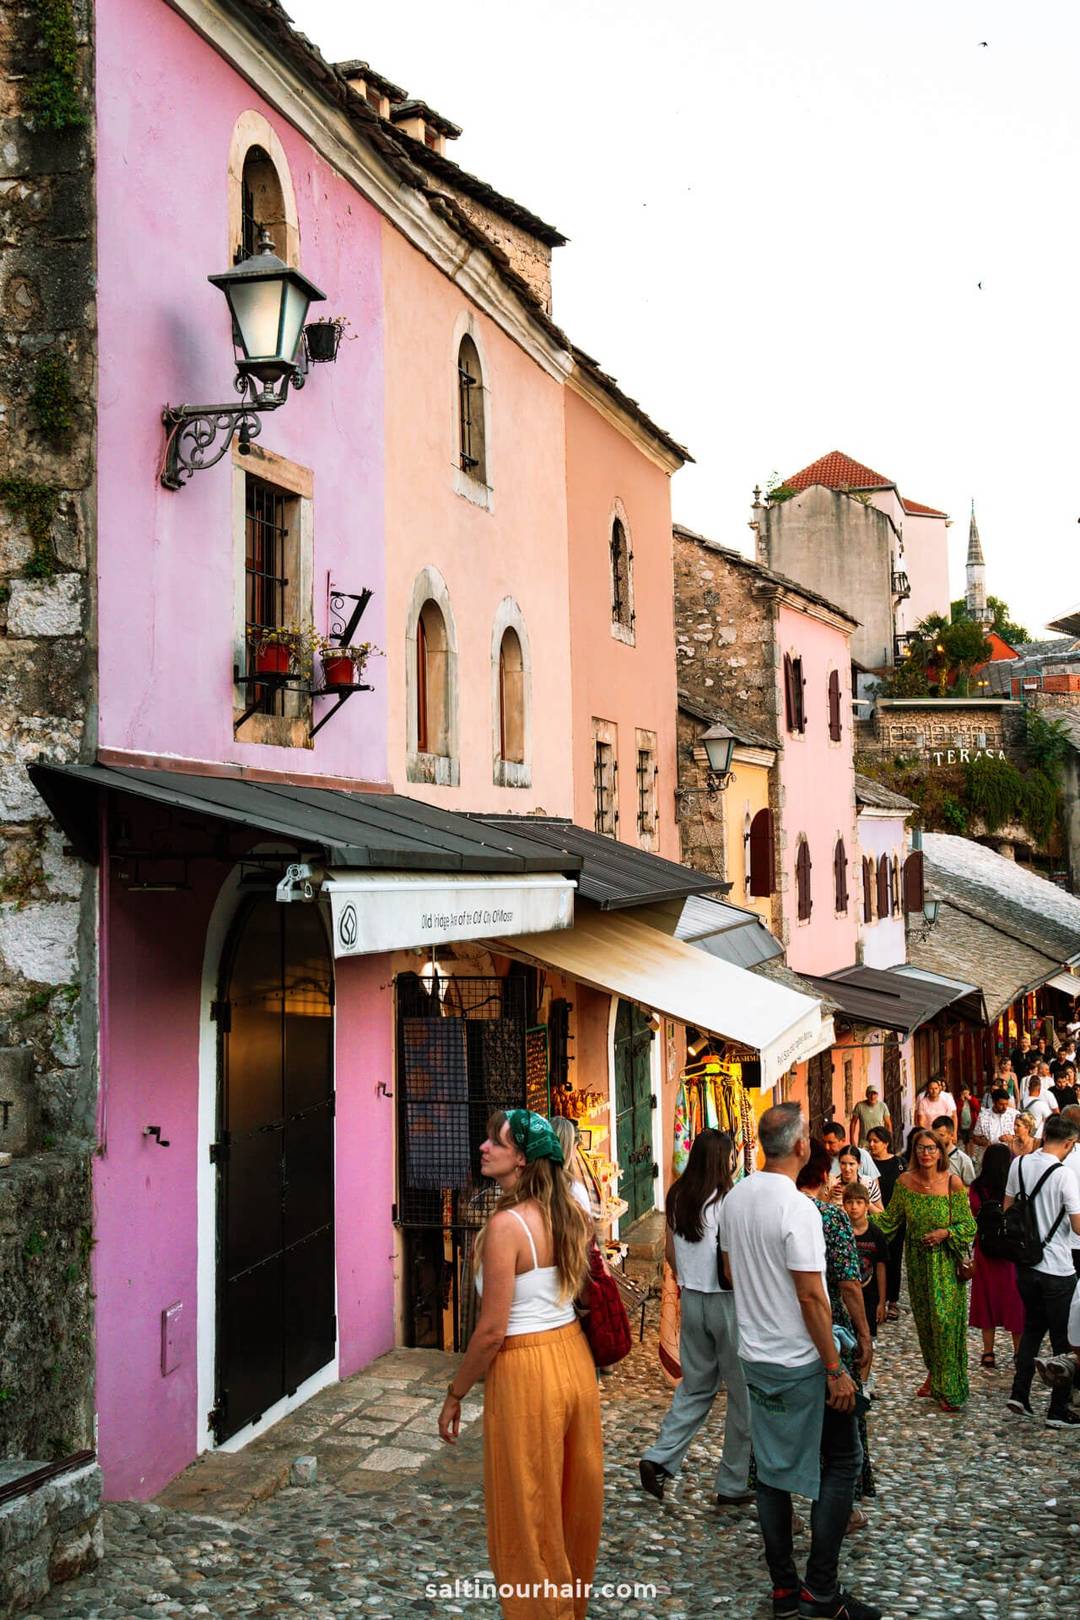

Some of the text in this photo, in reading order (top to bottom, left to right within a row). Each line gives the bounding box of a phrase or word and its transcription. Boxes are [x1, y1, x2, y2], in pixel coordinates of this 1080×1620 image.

[933, 748, 1008, 767] TERASA
[421, 912, 433, 929] Old
[483, 909, 492, 926] Cy
